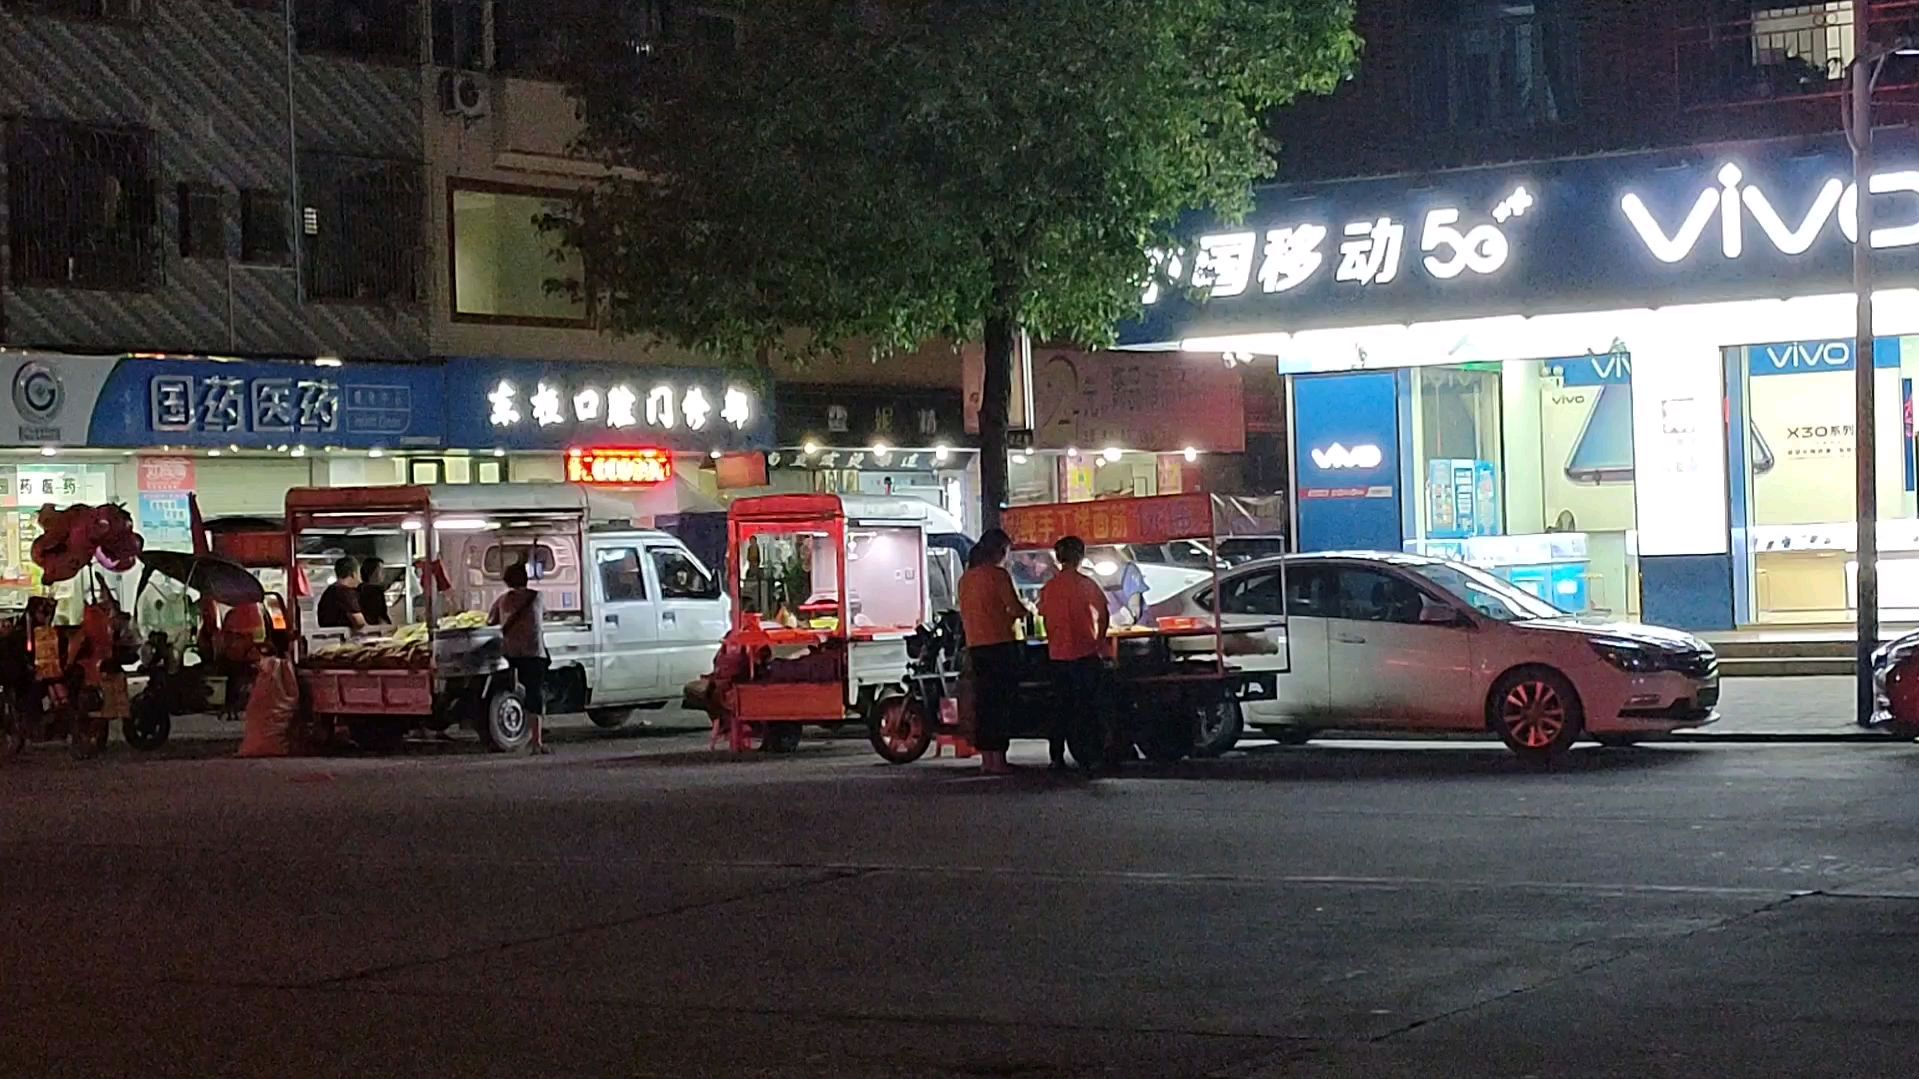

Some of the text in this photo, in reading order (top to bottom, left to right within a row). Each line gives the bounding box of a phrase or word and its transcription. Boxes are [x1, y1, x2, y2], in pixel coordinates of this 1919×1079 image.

[1621, 162, 1919, 263] vivo
[1766, 341, 1850, 368] vivo
[150, 374, 341, 432] 国药医药
[1552, 395, 1585, 405] vivo
[1786, 424, 1854, 439] X30系列
